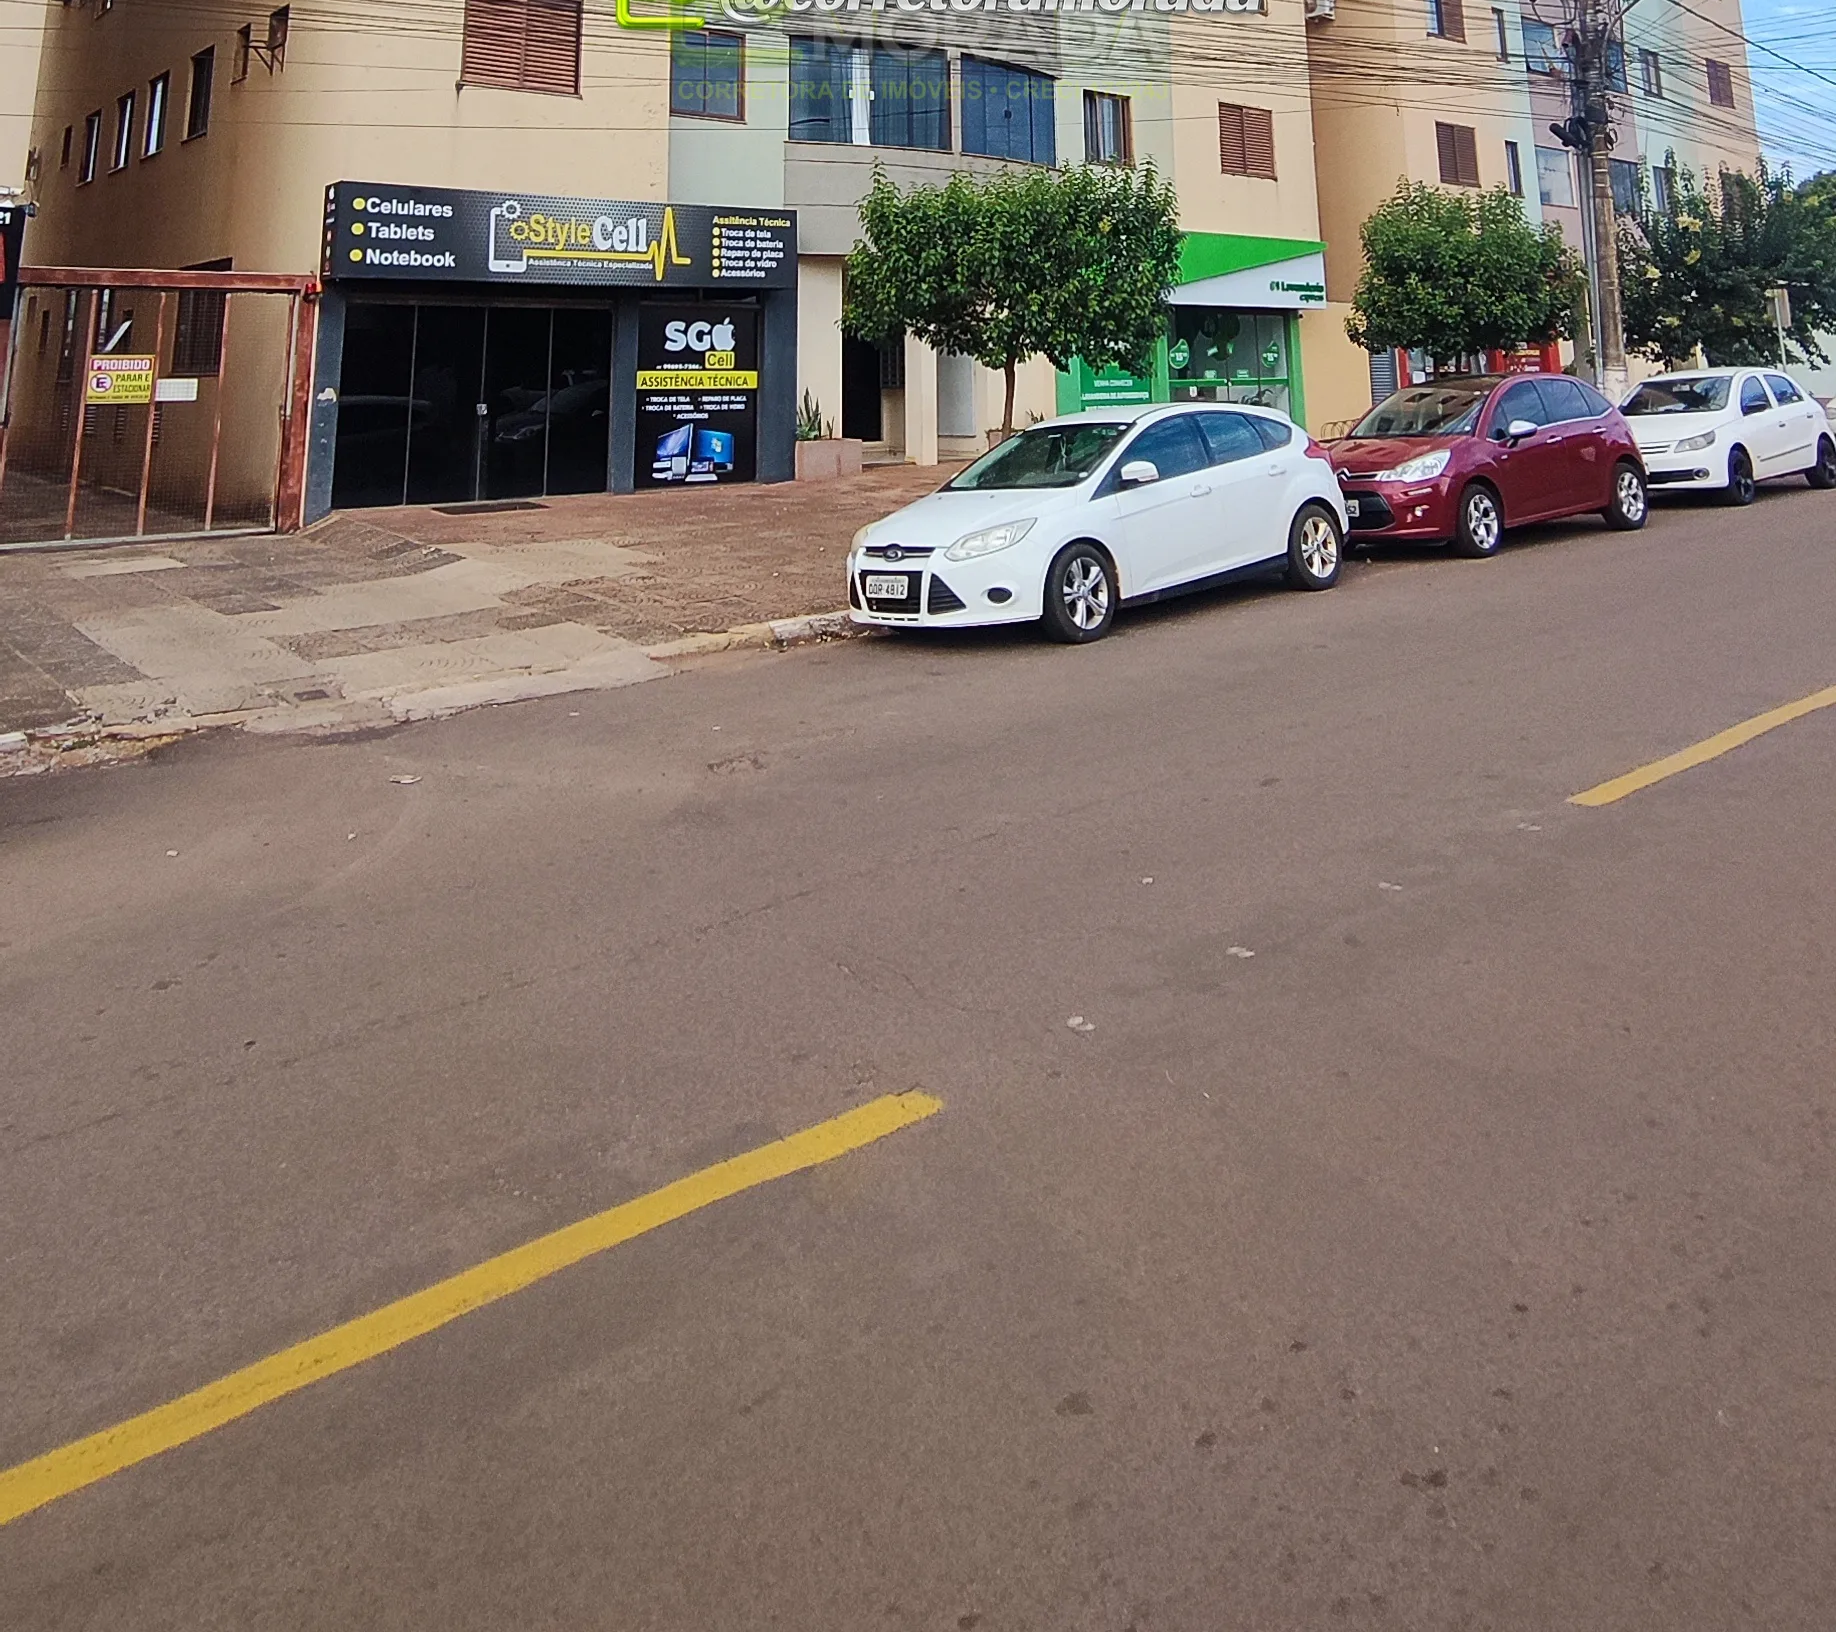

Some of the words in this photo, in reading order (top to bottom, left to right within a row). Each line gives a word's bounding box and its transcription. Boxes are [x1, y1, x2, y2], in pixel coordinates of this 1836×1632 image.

[366, 197, 453, 218] Celulares
[367, 222, 435, 241] Tablets
[721, 228, 744, 237] Troca
[745, 229, 755, 238] de
[756, 230, 772, 239] tela
[721, 238, 744, 247] Troca
[745, 239, 755, 248] de
[756, 239, 784, 248] bateria
[365, 248, 456, 267] Notebook
[720, 258, 744, 267] Troca
[745, 259, 755, 268] de
[756, 259, 777, 268] vidro
[93, 359, 151, 371] PROIBIDO
[707, 353, 733, 367] Cell
[115, 373, 143, 382] PARAR
[145, 373, 150, 382] E
[640, 373, 705, 388] ASSISTÊNCIA
[708, 373, 749, 387] TÉCNICA
[113, 384, 151, 393] ESTACIONAR
